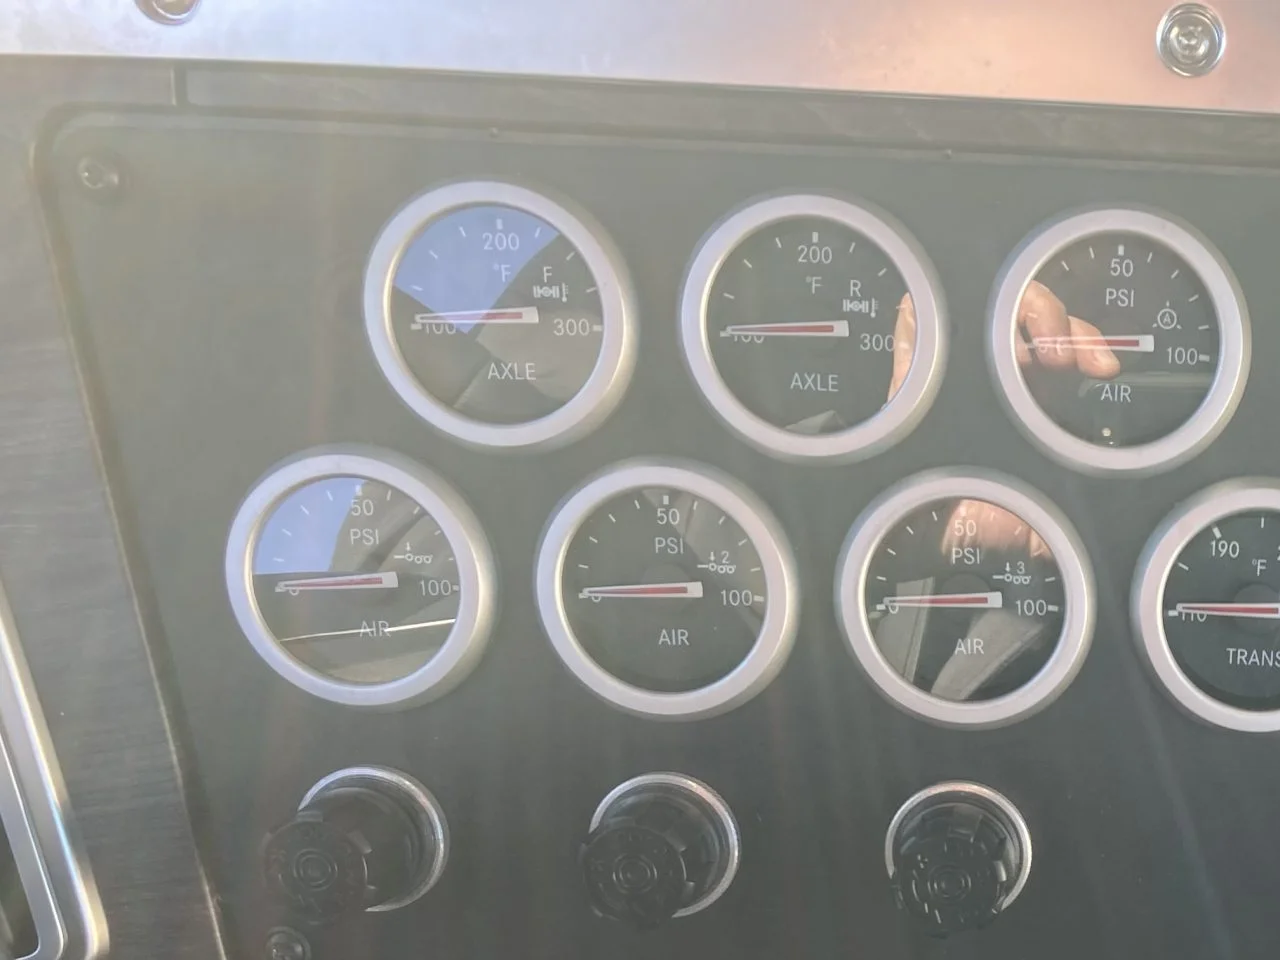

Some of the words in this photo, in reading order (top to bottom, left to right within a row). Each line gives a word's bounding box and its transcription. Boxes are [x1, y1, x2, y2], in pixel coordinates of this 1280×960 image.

[482, 231, 519, 251] 200
[798, 245, 833, 264] 200
[543, 266, 553, 282] F
[1110, 259, 1134, 277] 50
[850, 280, 861, 297] R
[1105, 288, 1134, 307] PSI
[553, 318, 589, 336] 300
[859, 333, 895, 351] 300
[1167, 348, 1198, 365] 100
[487, 362, 537, 380] AXLE
[790, 372, 839, 391] AXLE
[1101, 385, 1131, 402] AIR
[351, 500, 373, 516] 50
[657, 509, 680, 525] 50
[350, 529, 380, 545] PSI
[954, 520, 977, 537] 50
[655, 538, 684, 554] PSI
[1210, 541, 1240, 558] 190
[722, 551, 730, 563] 2
[952, 548, 981, 565] PSI
[1016, 561, 1025, 574] 3
[420, 580, 451, 596] 100
[721, 590, 752, 606] 100
[1015, 600, 1046, 616] 100
[360, 621, 391, 638] AIR
[658, 629, 690, 646] AIR
[954, 638, 984, 656] AIR
